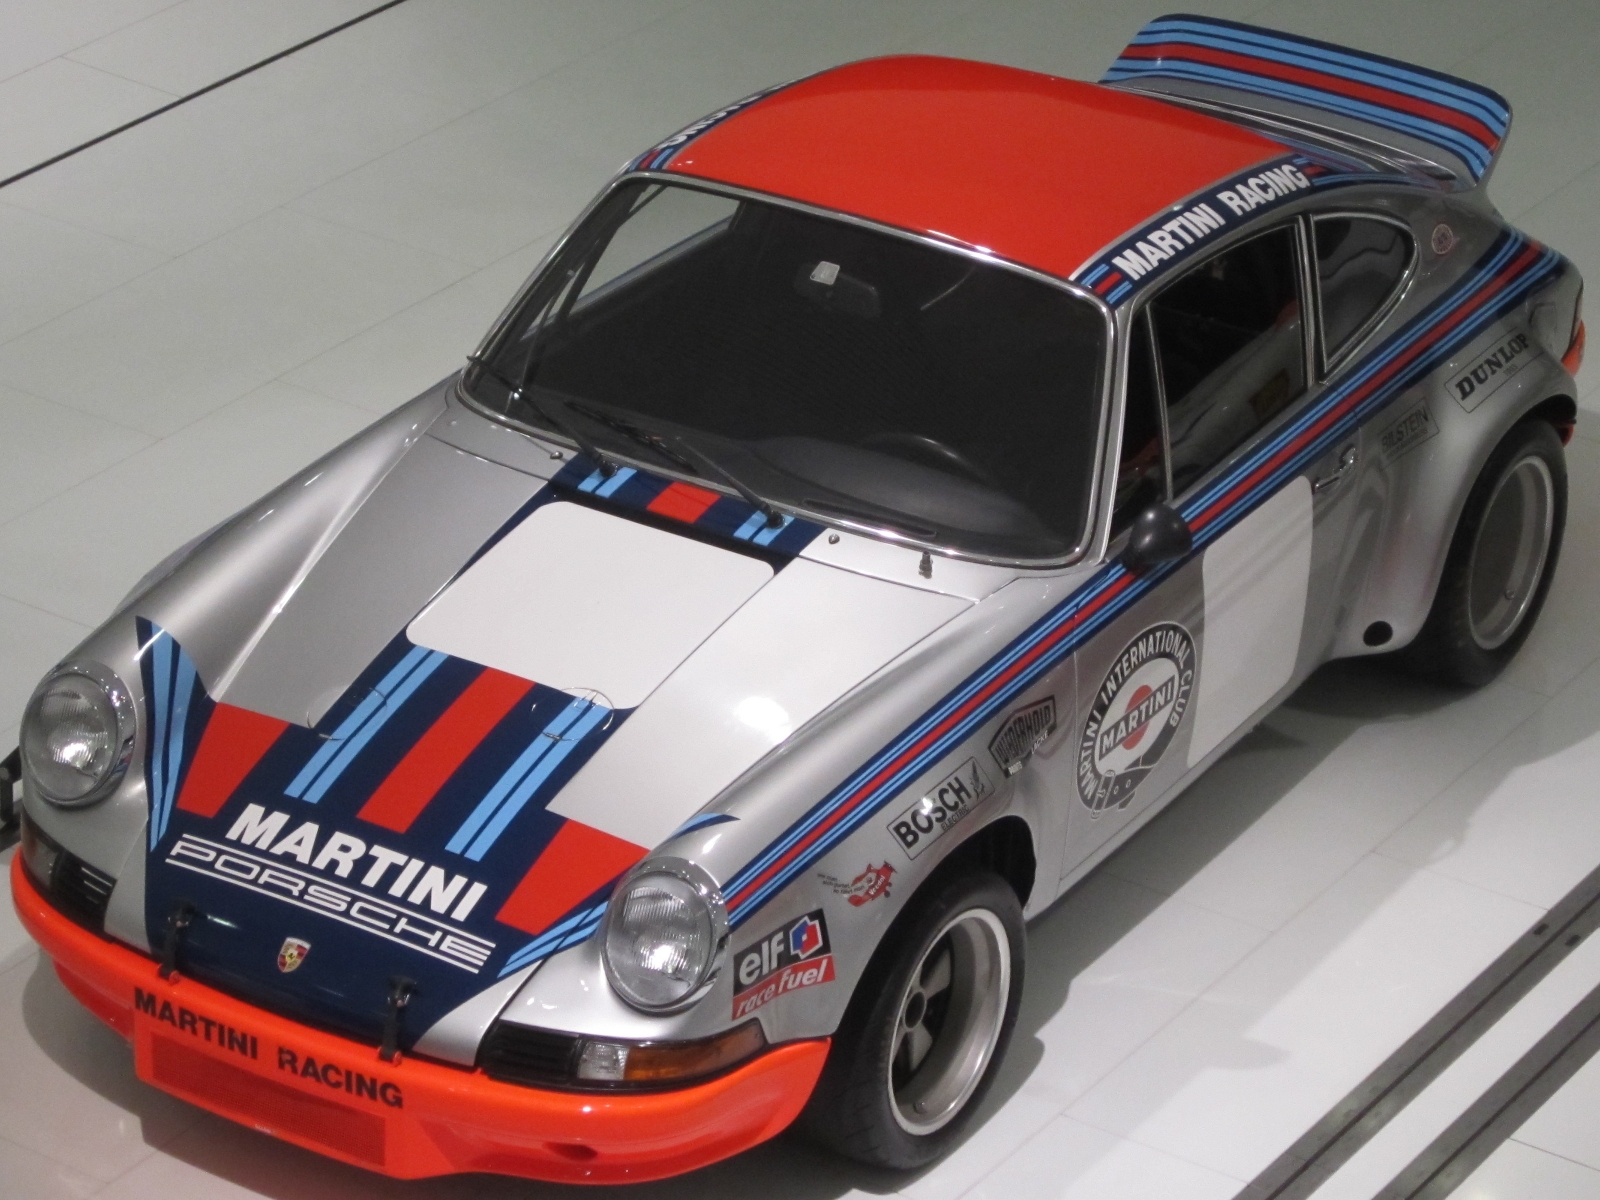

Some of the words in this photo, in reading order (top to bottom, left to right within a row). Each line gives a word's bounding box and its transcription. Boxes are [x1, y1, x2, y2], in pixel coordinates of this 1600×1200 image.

[1112, 203, 1226, 281] MARTINI
[1216, 164, 1311, 216] RACING
[1455, 333, 1529, 401] DUNLOP
[1080, 710, 1102, 800] MARTINI
[1101, 630, 1190, 705] INTERNATIONAL
[1170, 669, 1193, 727] CLUB
[1102, 682, 1173, 750] MARTINI
[893, 776, 972, 849] BOSCH
[225, 803, 488, 922] MARTINI
[868, 875, 886, 896] Veedol
[169, 839, 492, 967] PORSCHE
[735, 985, 776, 1018] race
[778, 959, 829, 994] fuel
[739, 931, 785, 985] elf
[134, 987, 258, 1060] MARTINI
[277, 1046, 404, 1109] RACING
